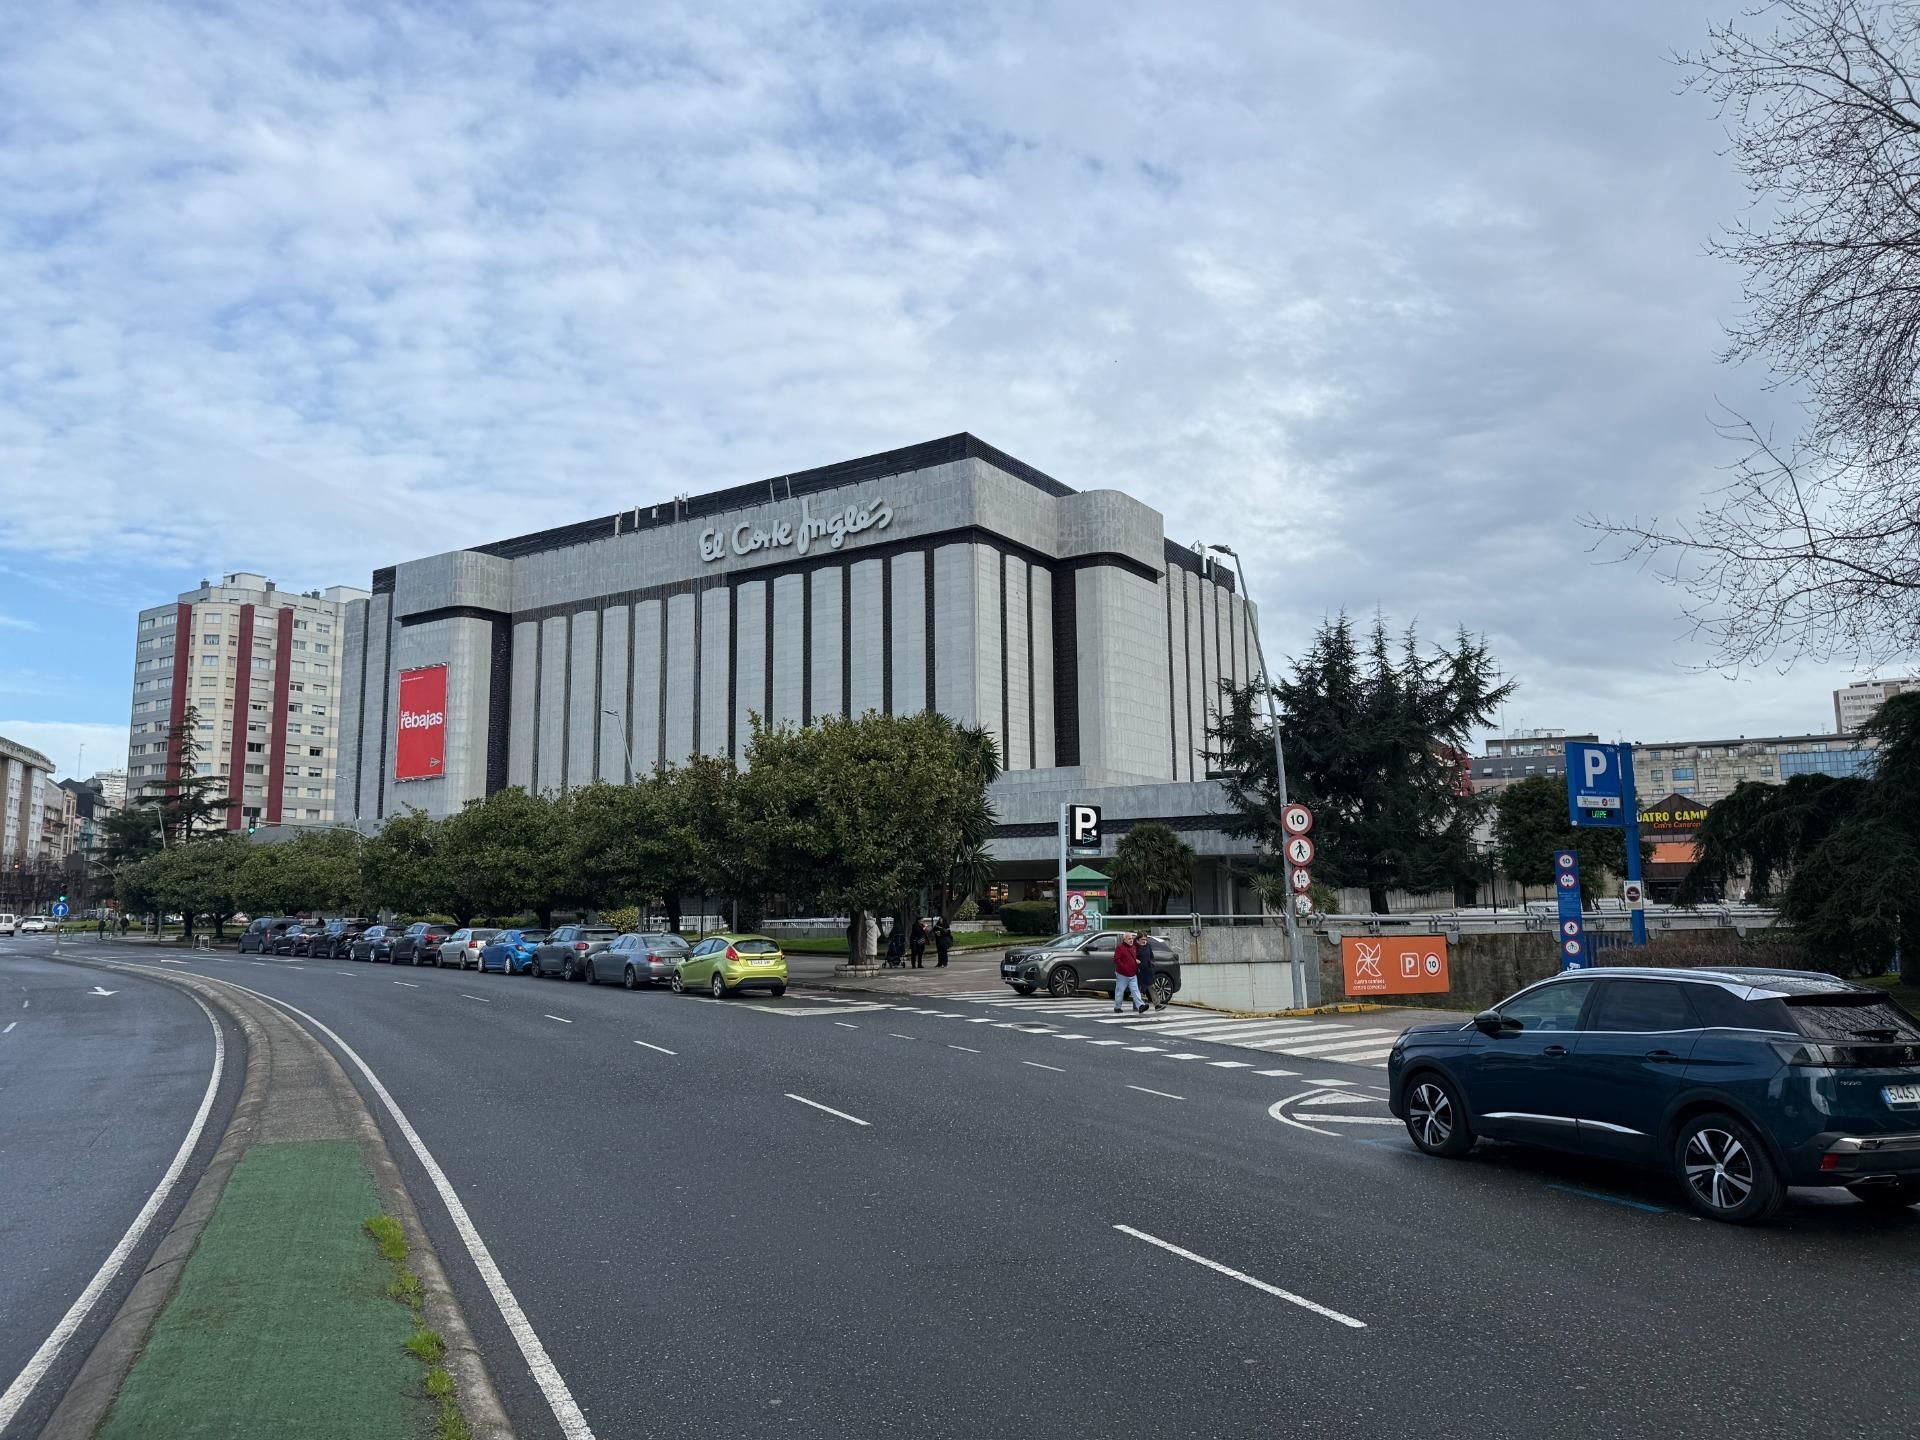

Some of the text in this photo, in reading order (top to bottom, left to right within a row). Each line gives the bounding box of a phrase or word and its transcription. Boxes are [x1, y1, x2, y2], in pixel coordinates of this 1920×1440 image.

[699, 497, 894, 562] El Corte Inglés
[400, 709, 443, 730] rebajas
[1583, 749, 1607, 788] P
[1075, 807, 1097, 841] P
[1290, 814, 1305, 825] 10
[1636, 811, 1670, 823] UATRO
[1405, 957, 1415, 973] P
[1428, 960, 1437, 969] 10
